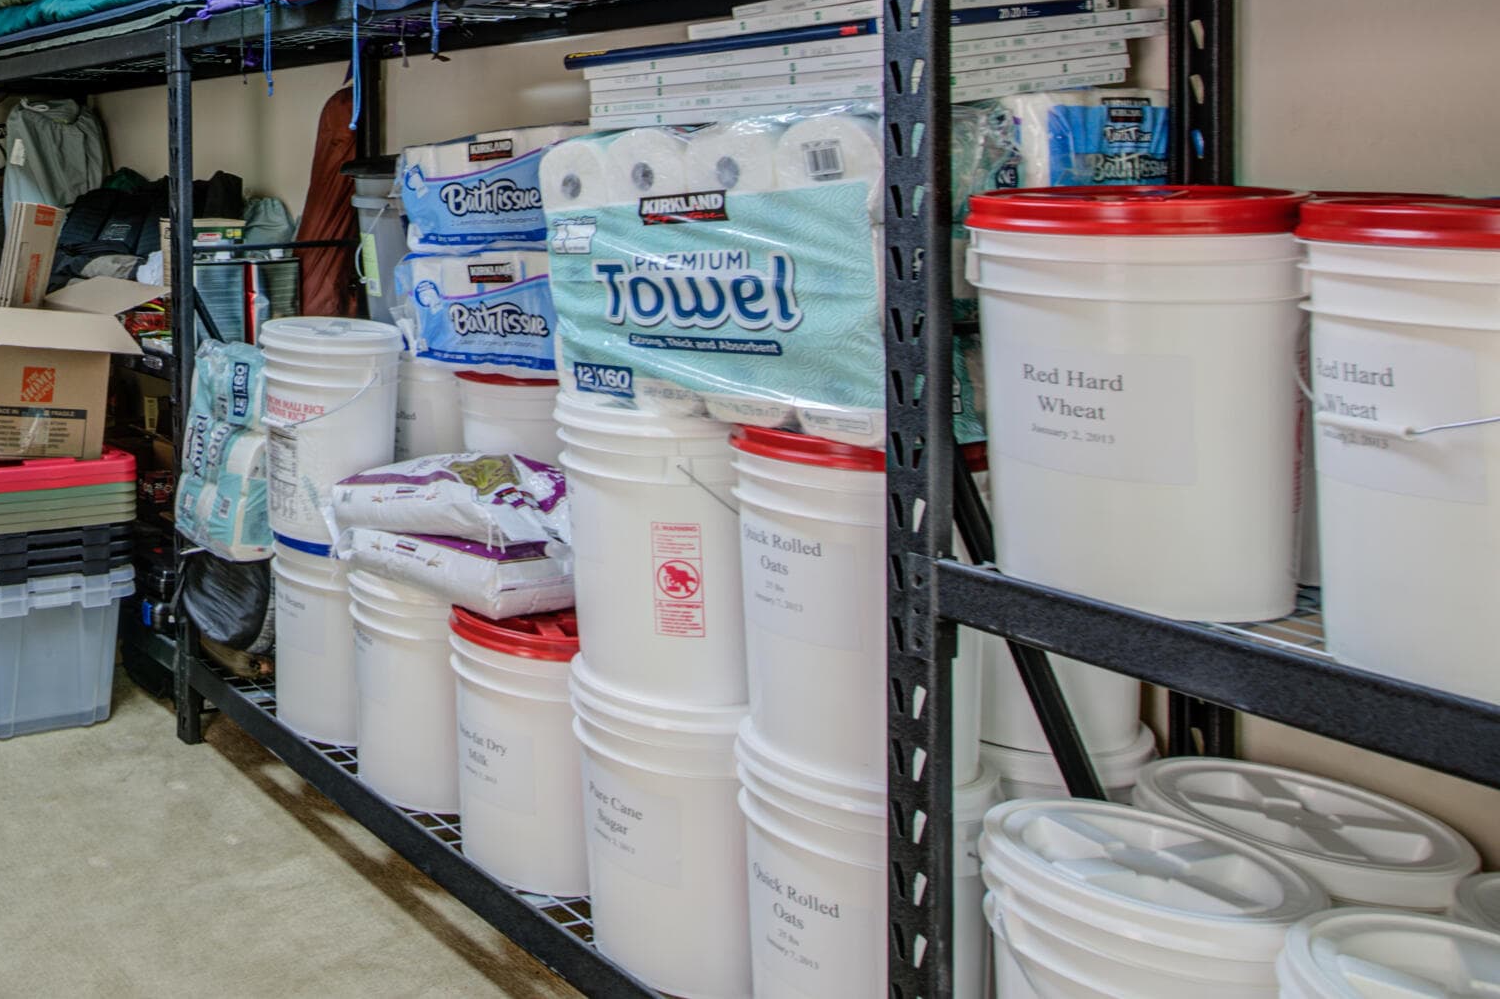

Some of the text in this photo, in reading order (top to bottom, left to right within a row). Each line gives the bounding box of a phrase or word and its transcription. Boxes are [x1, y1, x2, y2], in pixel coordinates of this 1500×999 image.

[470, 140, 511, 155] KIRKLAND
[642, 194, 724, 214] KIRKLAND
[469, 263, 514, 277] KIRKLAND
[634, 252, 750, 271] PREMIUM
[595, 254, 797, 322] Towel
[667, 337, 694, 348] Thick
[695, 340, 717, 350] and
[719, 340, 779, 353] Absorbent
[20, 368, 55, 401] HOME
[597, 367, 631, 388] 160
[1023, 362, 1124, 392] Red Hard
[1343, 362, 1395, 388] Hard
[1038, 394, 1106, 420] Wheat
[771, 534, 823, 557] Rolled
[760, 554, 789, 576] Oats
[486, 738, 508, 757] Dry
[597, 806, 629, 836] Sugar
[610, 796, 645, 822] Cane
[753, 861, 841, 920] Quick Rolled
[772, 902, 805, 930] Oats
